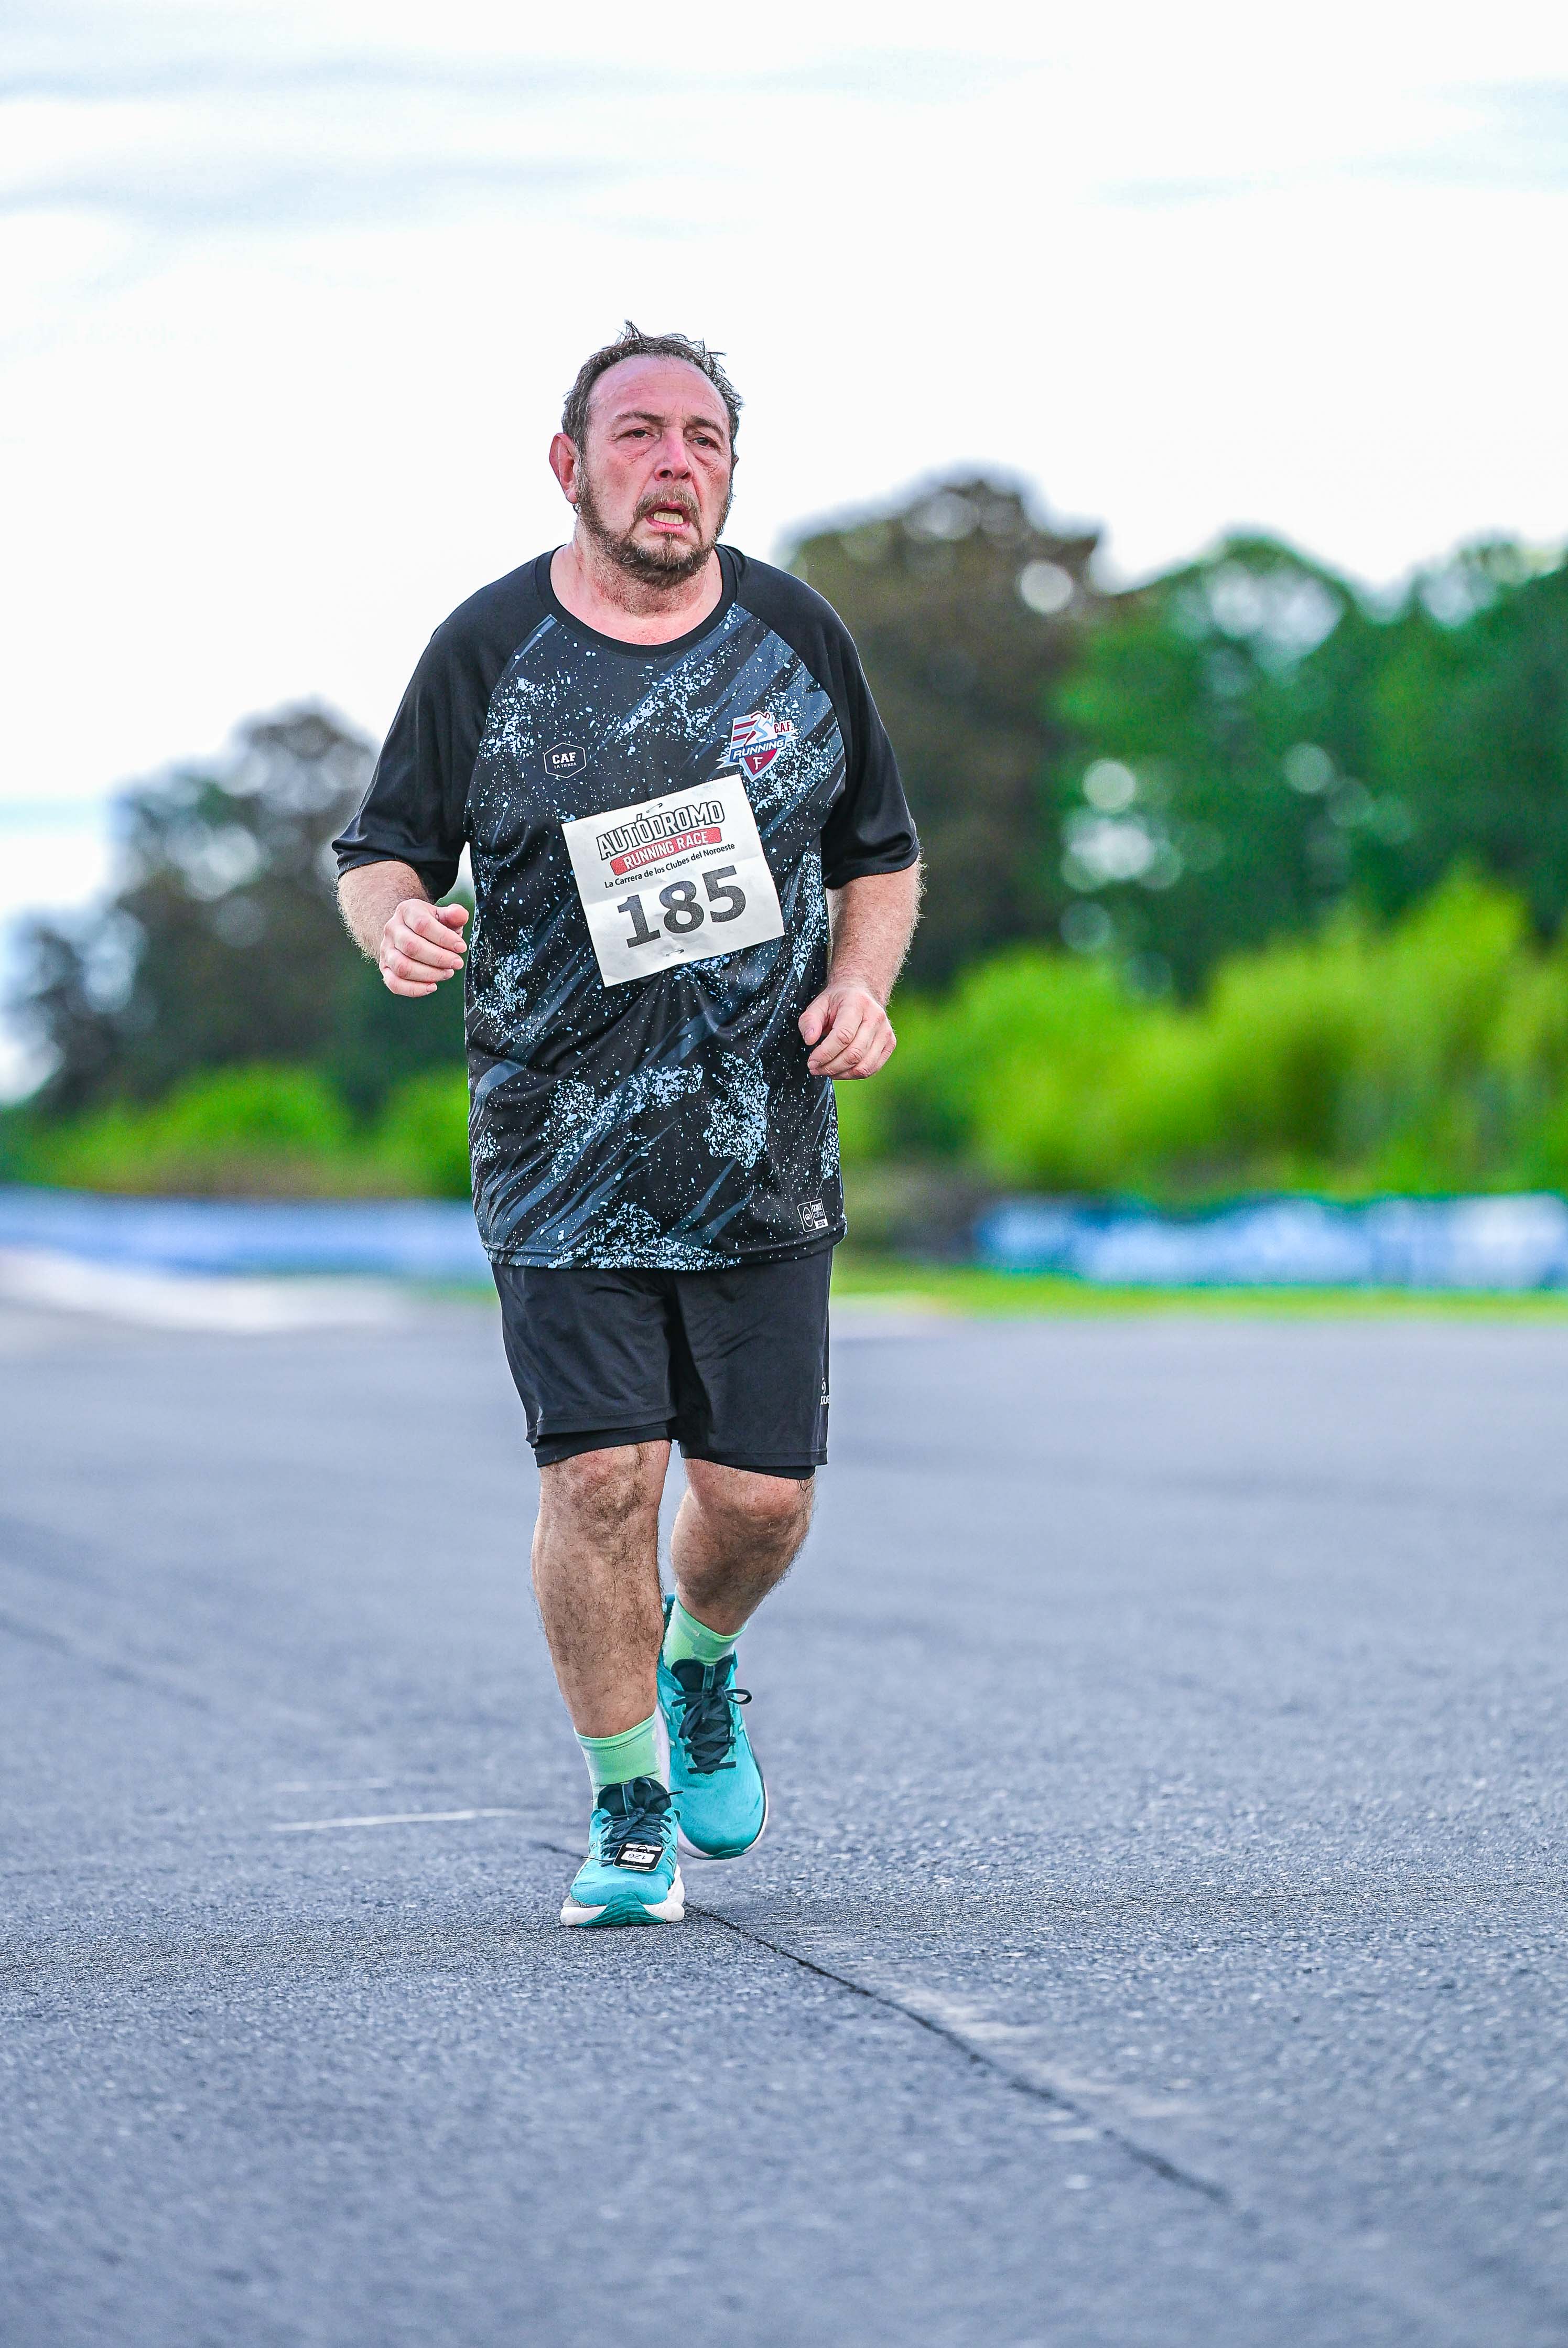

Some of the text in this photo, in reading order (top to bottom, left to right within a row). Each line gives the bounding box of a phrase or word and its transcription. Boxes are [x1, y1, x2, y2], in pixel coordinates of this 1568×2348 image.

[552, 752, 576, 764] CAF
[732, 739, 784, 760] RUNNING
[752, 756, 763, 770] F
[596, 801, 725, 860] AUTÓDROMO
[614, 873, 643, 886] Carrera
[644, 868, 654, 878] de
[654, 865, 665, 875] los
[666, 857, 690, 871] Clubes
[690, 851, 702, 865] del
[703, 843, 735, 857] Noroeste
[623, 831, 709, 869] RUNNING RACE
[617, 865, 747, 949] 185
